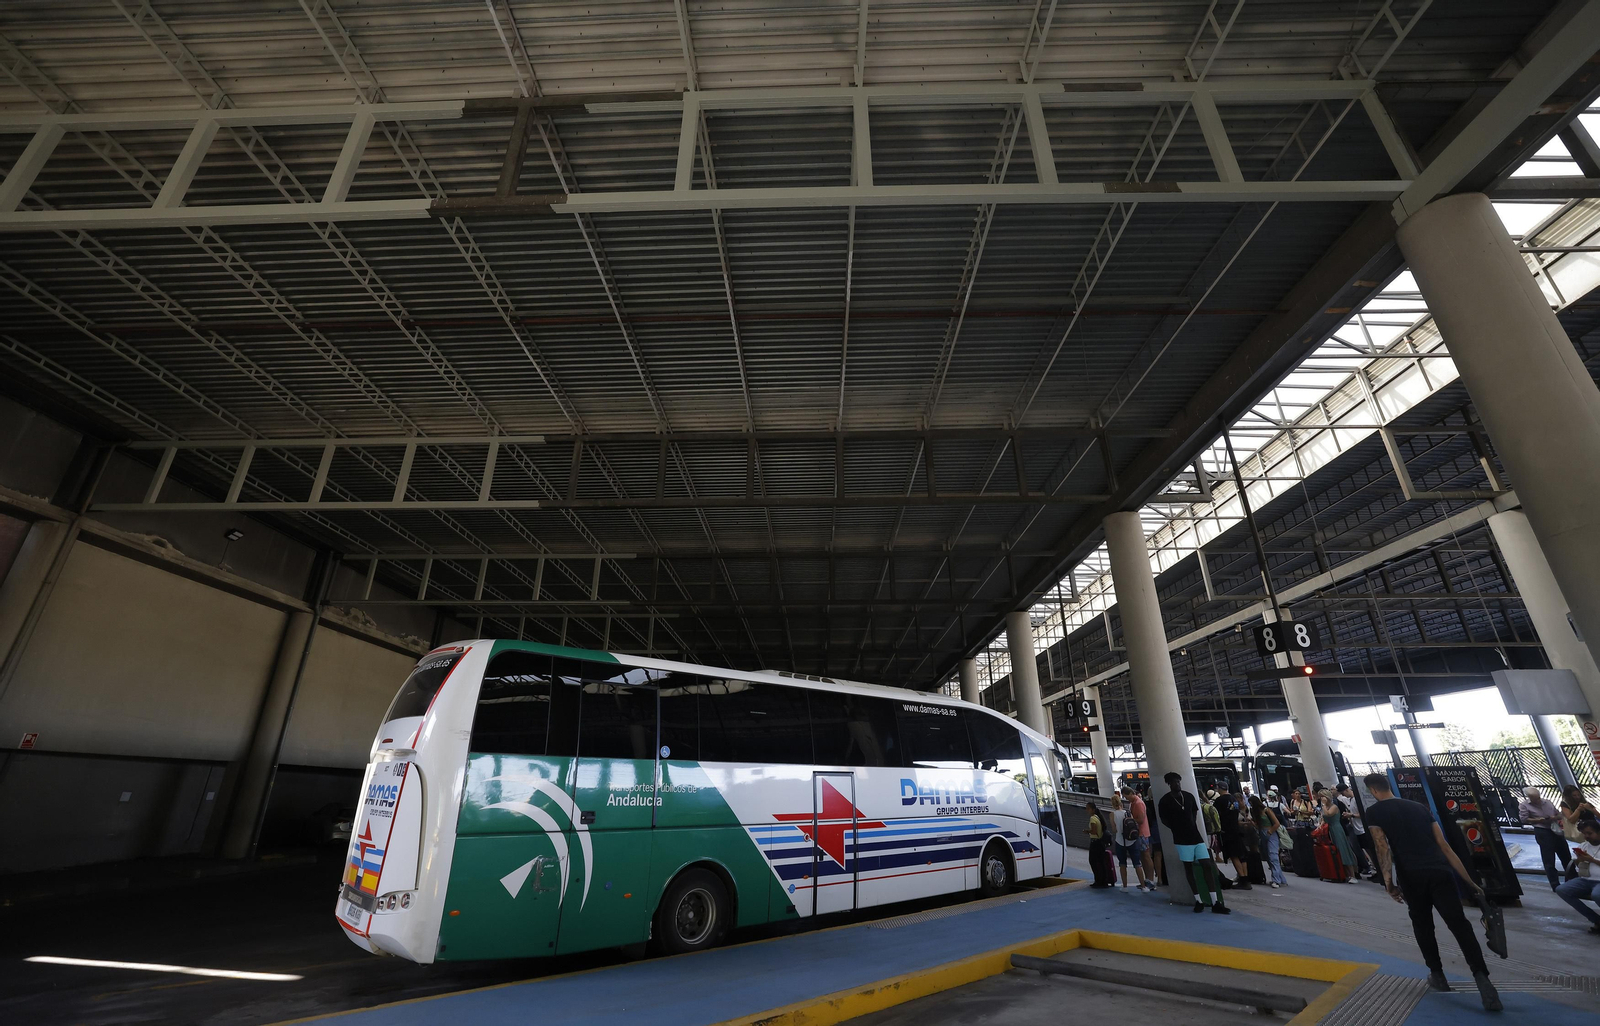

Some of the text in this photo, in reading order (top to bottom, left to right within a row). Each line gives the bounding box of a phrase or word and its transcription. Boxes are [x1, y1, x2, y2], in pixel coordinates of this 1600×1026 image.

[1263, 627, 1276, 651] 8
[1294, 623, 1311, 648] 8
[902, 703, 958, 717] www.damas-sa.es
[1067, 702, 1074, 717] 9
[1081, 700, 1091, 716] 9
[688, 784, 697, 794] de
[936, 805, 989, 816] GRUPO INTERBUS
